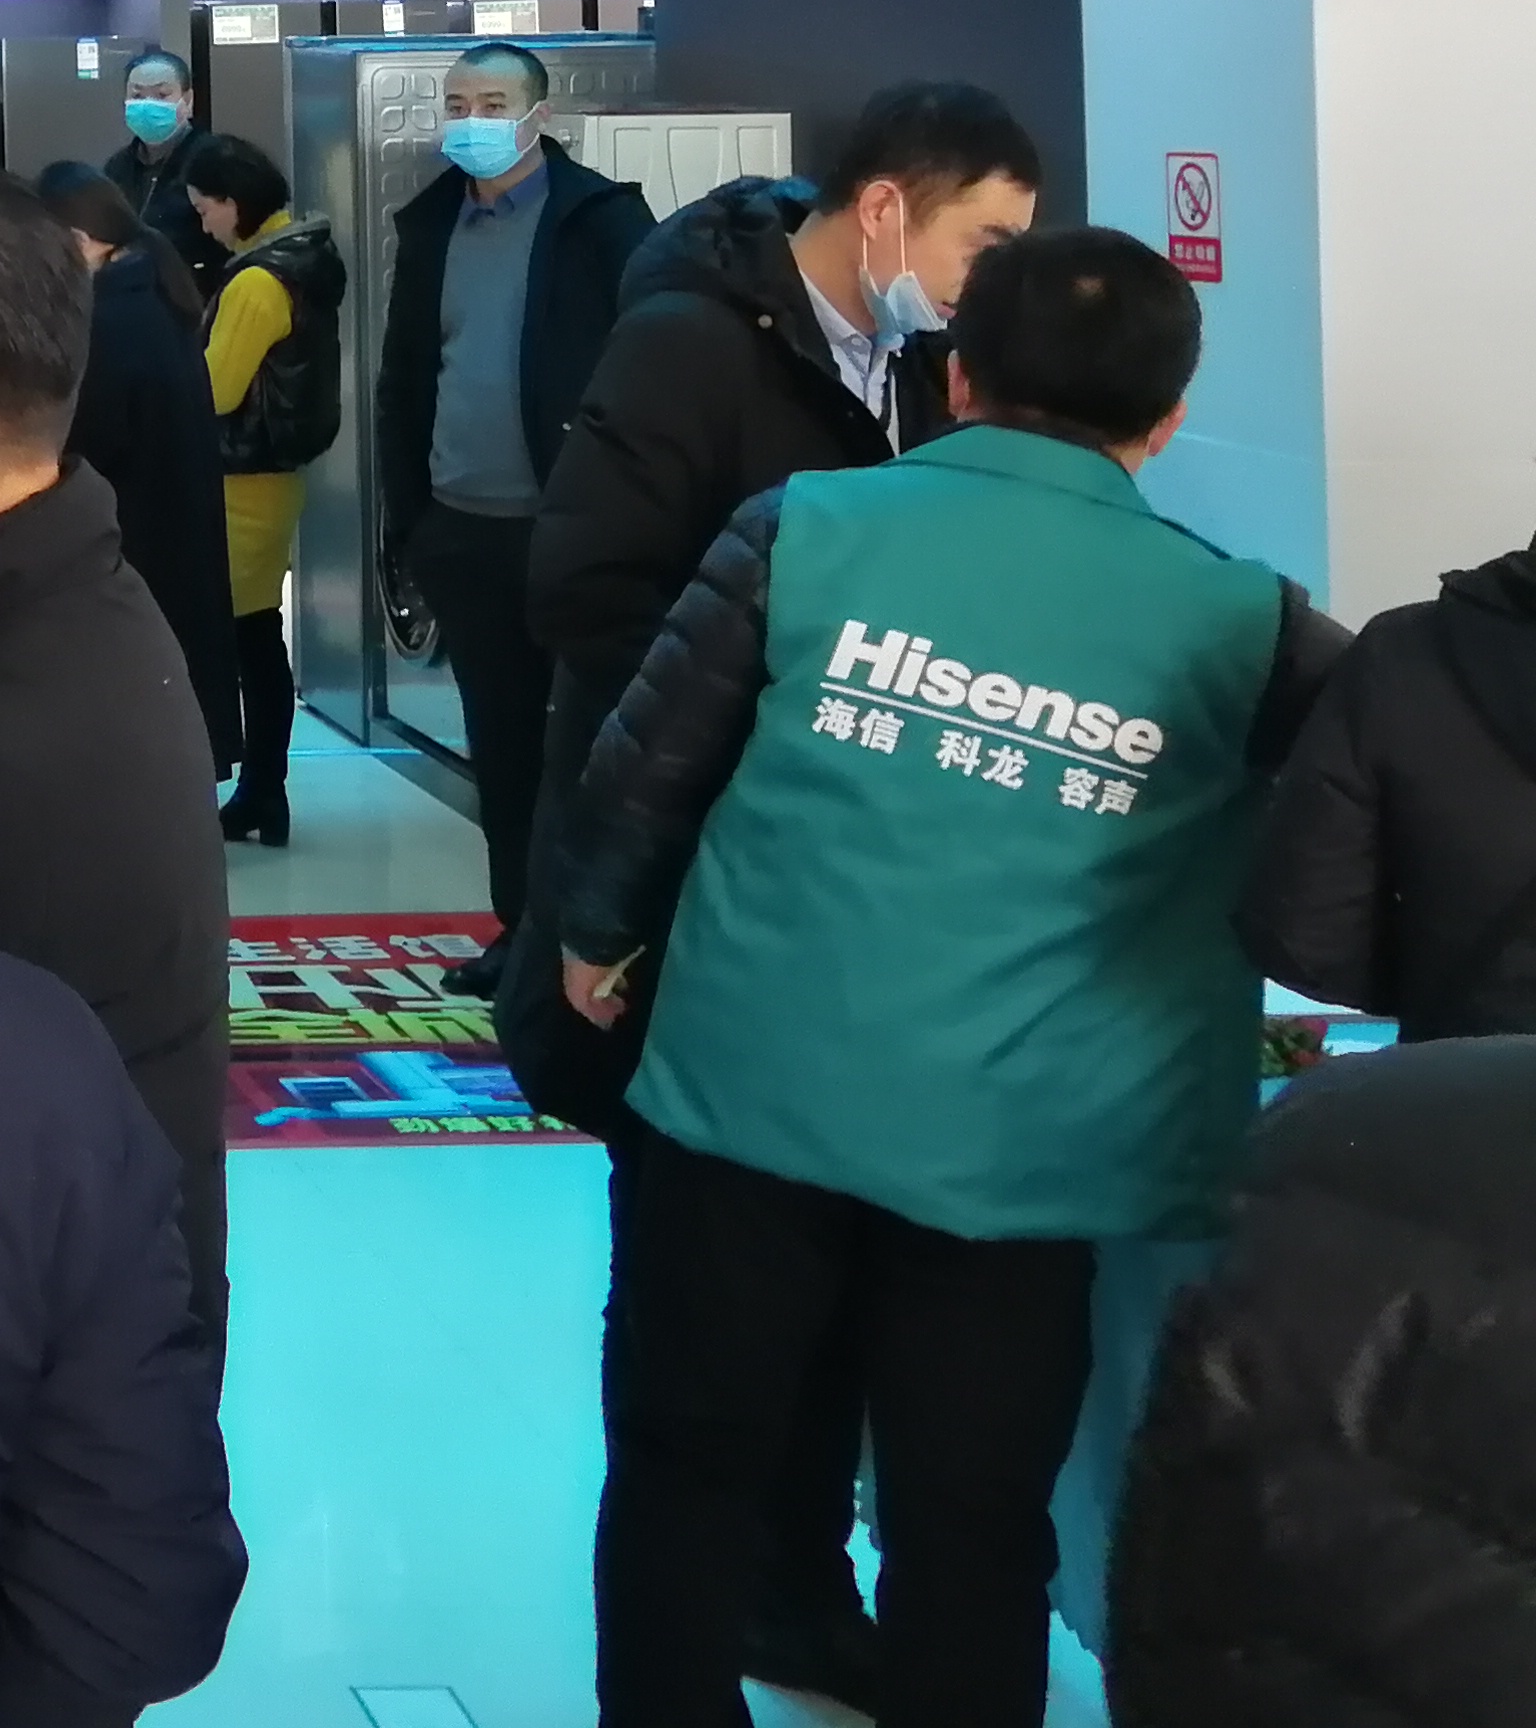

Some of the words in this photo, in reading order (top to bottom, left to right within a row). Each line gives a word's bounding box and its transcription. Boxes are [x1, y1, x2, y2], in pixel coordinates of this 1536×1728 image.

[811, 696, 905, 755] 海信
[935, 729, 1029, 791] 科龙
[1057, 766, 1139, 816] 容声
[825, 618, 1163, 765] Hisense
